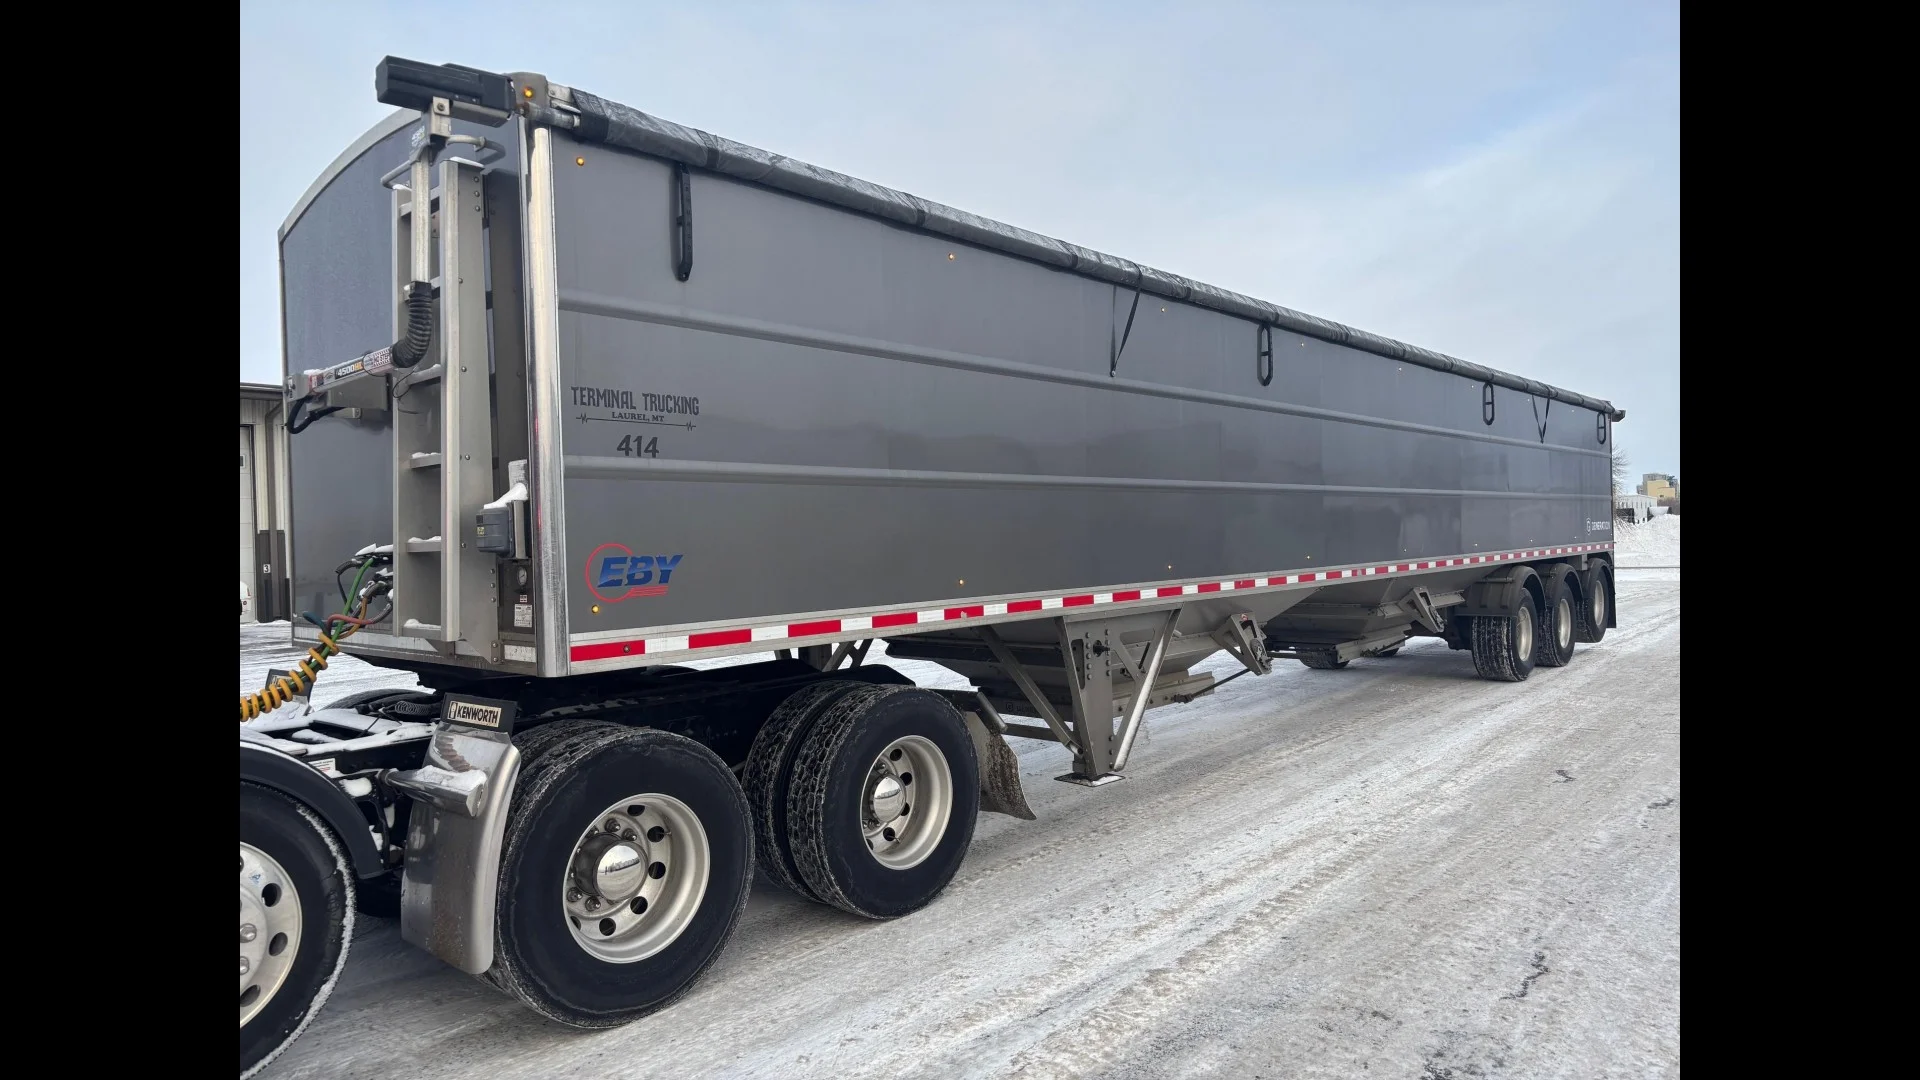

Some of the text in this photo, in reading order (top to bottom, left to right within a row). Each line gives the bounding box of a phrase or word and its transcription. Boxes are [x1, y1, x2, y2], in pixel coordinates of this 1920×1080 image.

[571, 386, 699, 416] TERMINAL TRUCKING
[611, 411, 665, 422] LAUREL, MT
[616, 434, 660, 458] 414
[264, 564, 270, 573] 3
[597, 554, 684, 588] EBY
[457, 705, 499, 724] KENWORTH
